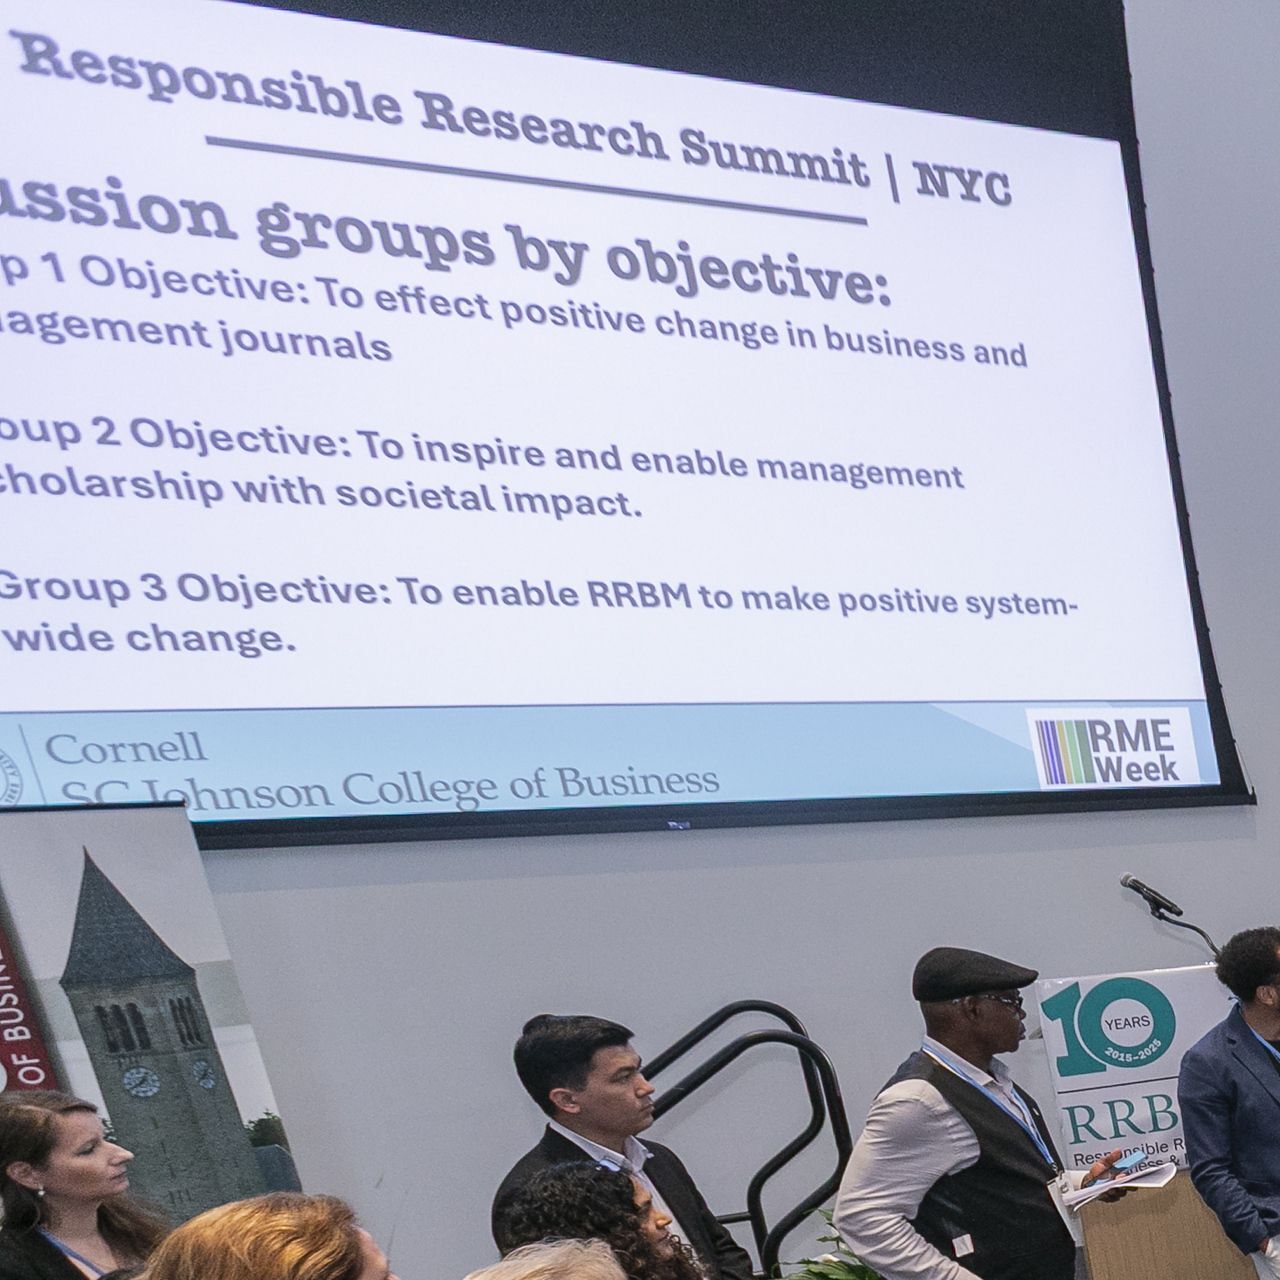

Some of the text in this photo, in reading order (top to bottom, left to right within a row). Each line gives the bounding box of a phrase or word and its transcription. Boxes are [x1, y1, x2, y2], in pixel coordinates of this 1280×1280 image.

[8, 30, 403, 125] Responsible
[413, 90, 670, 161] Research
[680, 128, 870, 188] Summit
[912, 161, 1012, 206] NYC
[257, 202, 496, 272] groups
[504, 224, 589, 286] by
[607, 238, 891, 306] objective:
[41, 252, 65, 282] 1
[80, 255, 309, 304] Objective:
[314, 277, 364, 308] To
[375, 285, 492, 320] effect
[500, 300, 645, 333] positive
[655, 310, 779, 349] change
[786, 320, 817, 348] in
[824, 324, 965, 361] business
[974, 343, 1027, 367] and
[0, 311, 392, 361] agement journals
[92, 416, 121, 445] 2
[130, 418, 351, 457] Objective:
[356, 430, 404, 459] To
[412, 433, 545, 470] inspire
[556, 445, 622, 470] and
[632, 449, 748, 477] enable
[757, 459, 965, 489] management
[232, 475, 325, 505] with
[336, 481, 496, 511] societal
[501, 485, 642, 520] impact.
[140, 573, 167, 601] 3
[178, 573, 391, 609] Objective:
[396, 577, 442, 604] To
[453, 580, 579, 606] enable
[587, 581, 691, 608] RRBM
[698, 586, 733, 609] to
[742, 586, 830, 610] make
[838, 588, 958, 617] positive
[966, 594, 1078, 619] system-
[1, 622, 296, 658] wide change.
[45, 731, 209, 764] Cornell
[1088, 719, 1174, 752] RME
[343, 771, 498, 810] College
[510, 767, 549, 799] of
[554, 766, 719, 797] Business
[1094, 754, 1179, 782] Week
[1041, 977, 1177, 1078] 10
[1104, 1016, 1151, 1031] YEARS
[11, 1053, 46, 1085] OF
